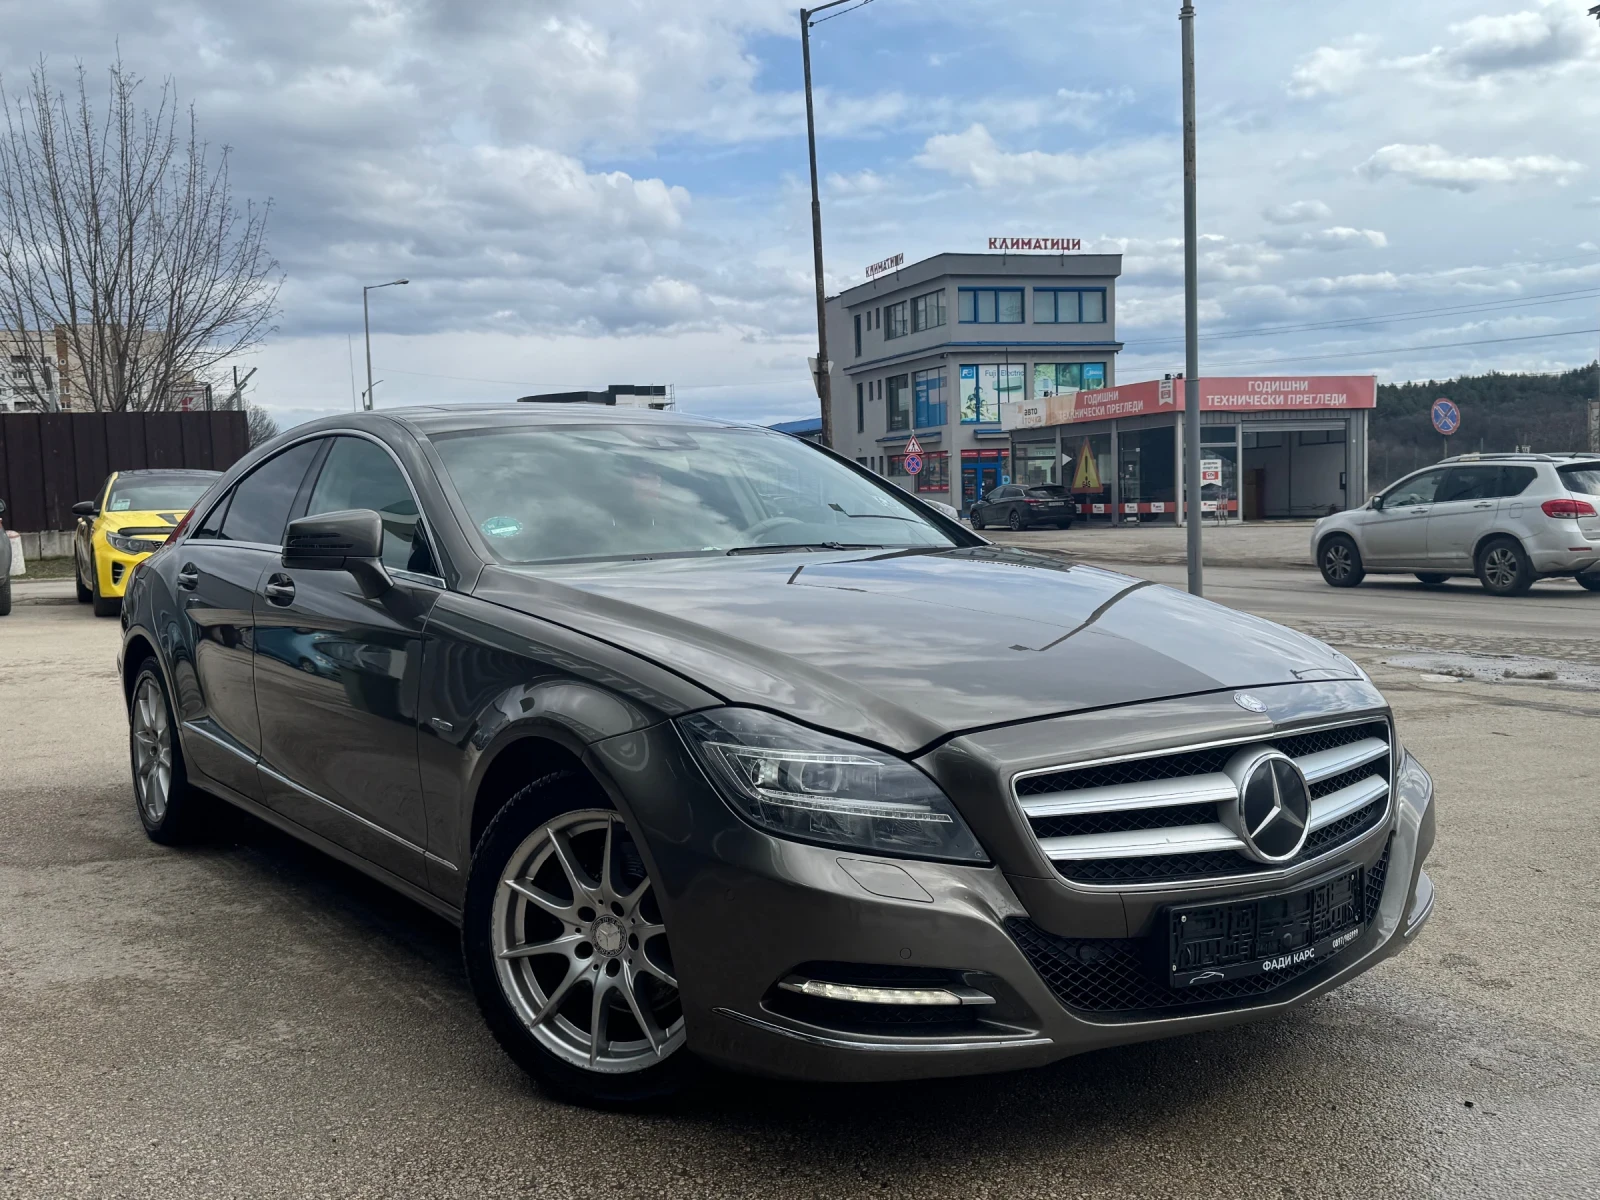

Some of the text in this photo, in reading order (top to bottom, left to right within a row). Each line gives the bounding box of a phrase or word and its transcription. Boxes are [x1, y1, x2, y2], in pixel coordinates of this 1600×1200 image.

[988, 237, 1081, 251] КЛИМАТИЦИ
[865, 252, 904, 278] КЛИМАТИЦИ
[984, 369, 1025, 379] Fuji Electric
[1248, 381, 1309, 394] ГОДИШНИ
[1084, 390, 1119, 405] ГОДИШНИ
[1206, 393, 1347, 406] ТЕХНИЧЕСКИ ПРЕГЛЕДИ
[1024, 407, 1038, 416] авто
[1107, 399, 1144, 415] ПРЕГЛЕДИ
[1262, 948, 1315, 971] ФАДИ КАРС
